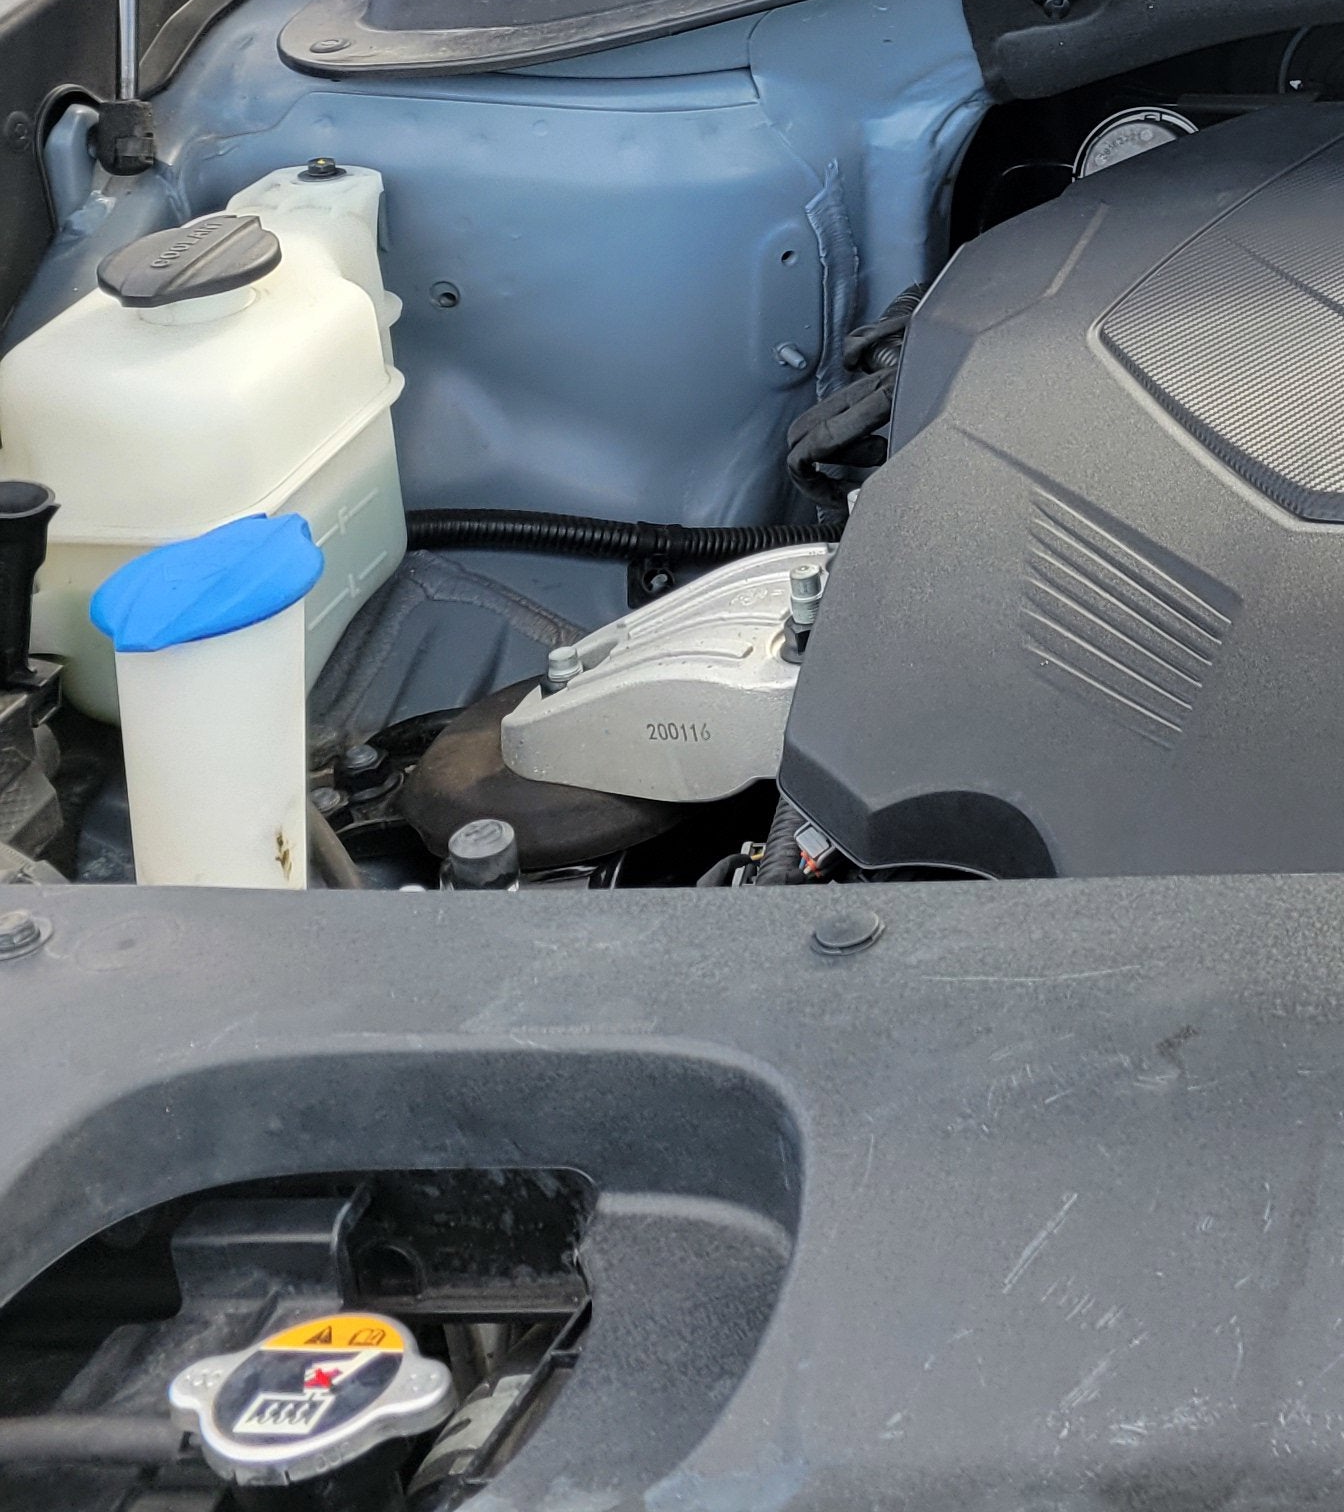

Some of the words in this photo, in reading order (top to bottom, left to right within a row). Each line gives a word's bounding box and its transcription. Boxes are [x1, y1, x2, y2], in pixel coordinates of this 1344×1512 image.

[150, 220, 224, 269] COOLANT
[338, 506, 350, 535] F
[348, 573, 361, 598] L
[646, 722, 711, 742] 200116
